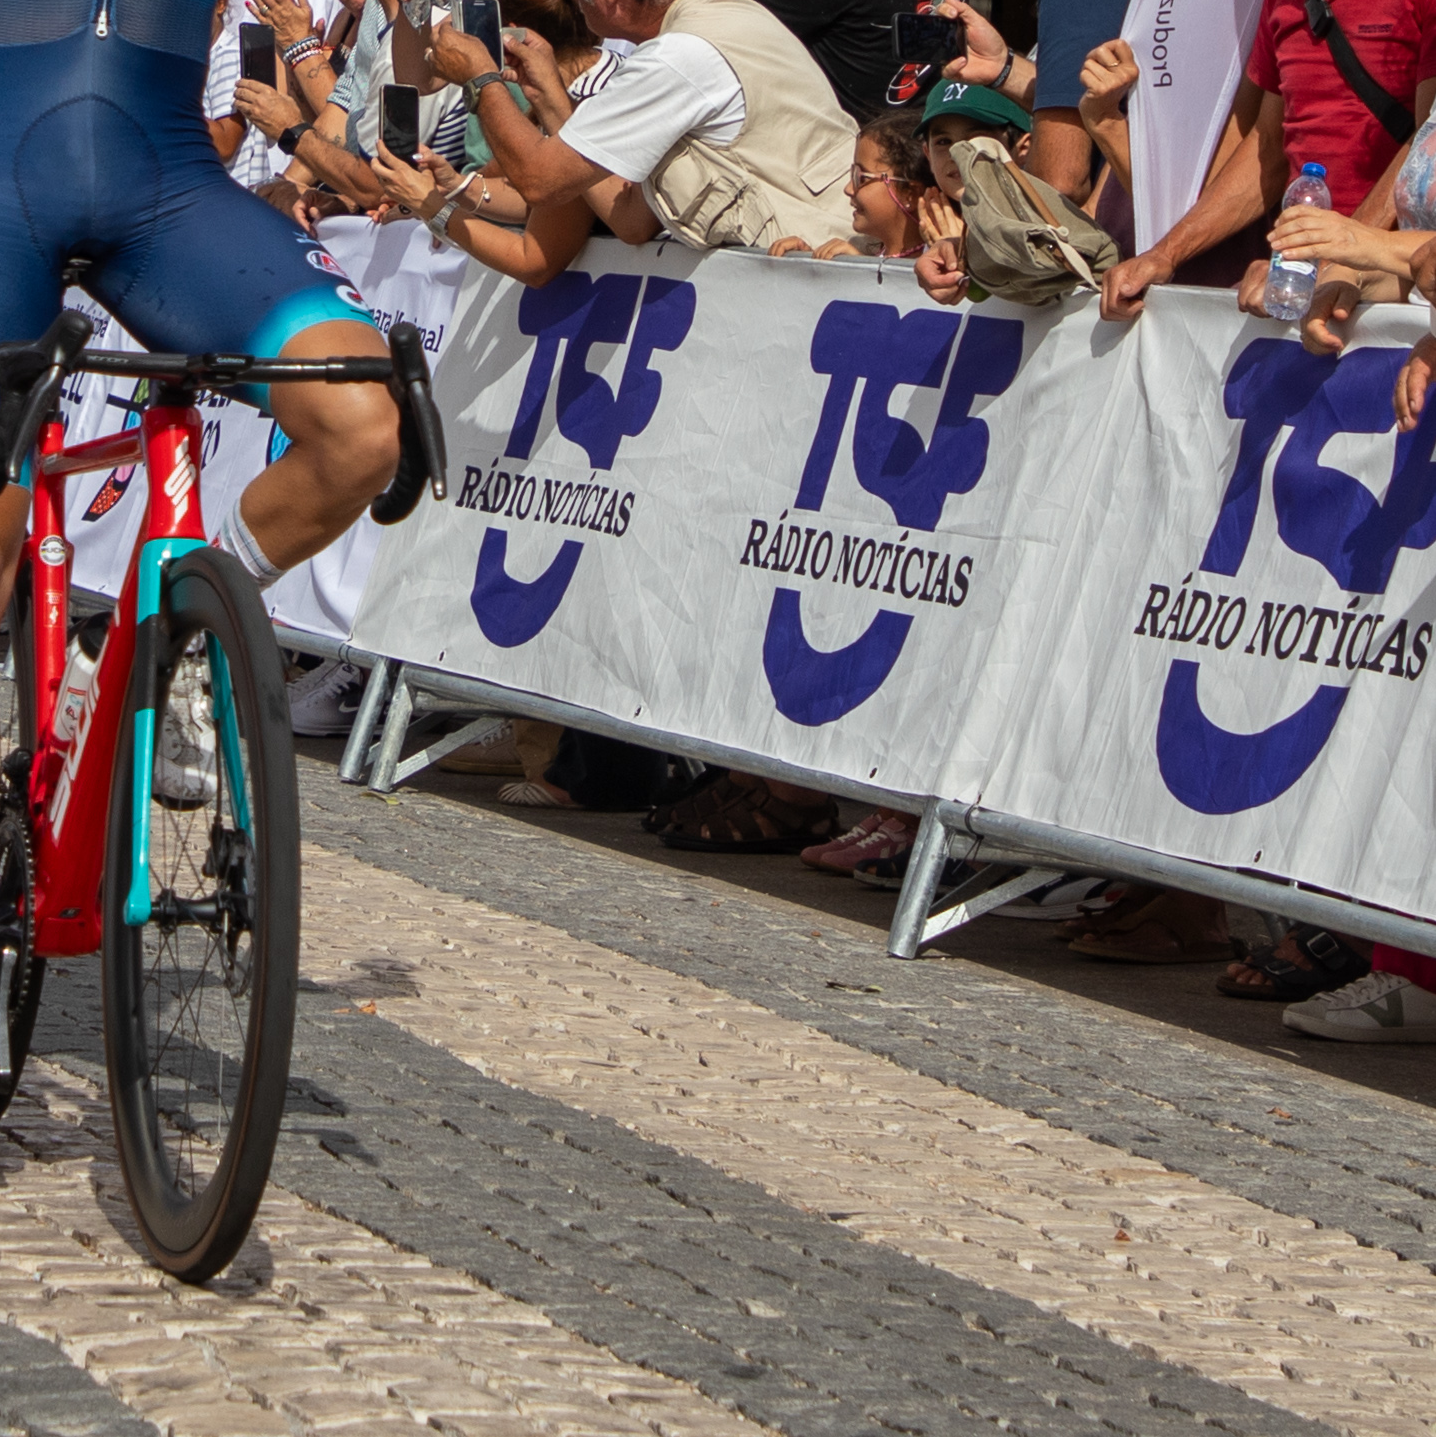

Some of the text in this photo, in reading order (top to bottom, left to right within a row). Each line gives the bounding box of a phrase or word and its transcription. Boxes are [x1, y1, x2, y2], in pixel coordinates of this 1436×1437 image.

[503, 269, 698, 473] TSF
[795, 298, 1025, 533] TSF
[454, 459, 637, 540] RÁDIO NOTÍCIAS
[740, 509, 976, 610] RÁDIO NOTÍCIAS
[1134, 574, 1435, 685] RÁDIO NOTÍCIAS
